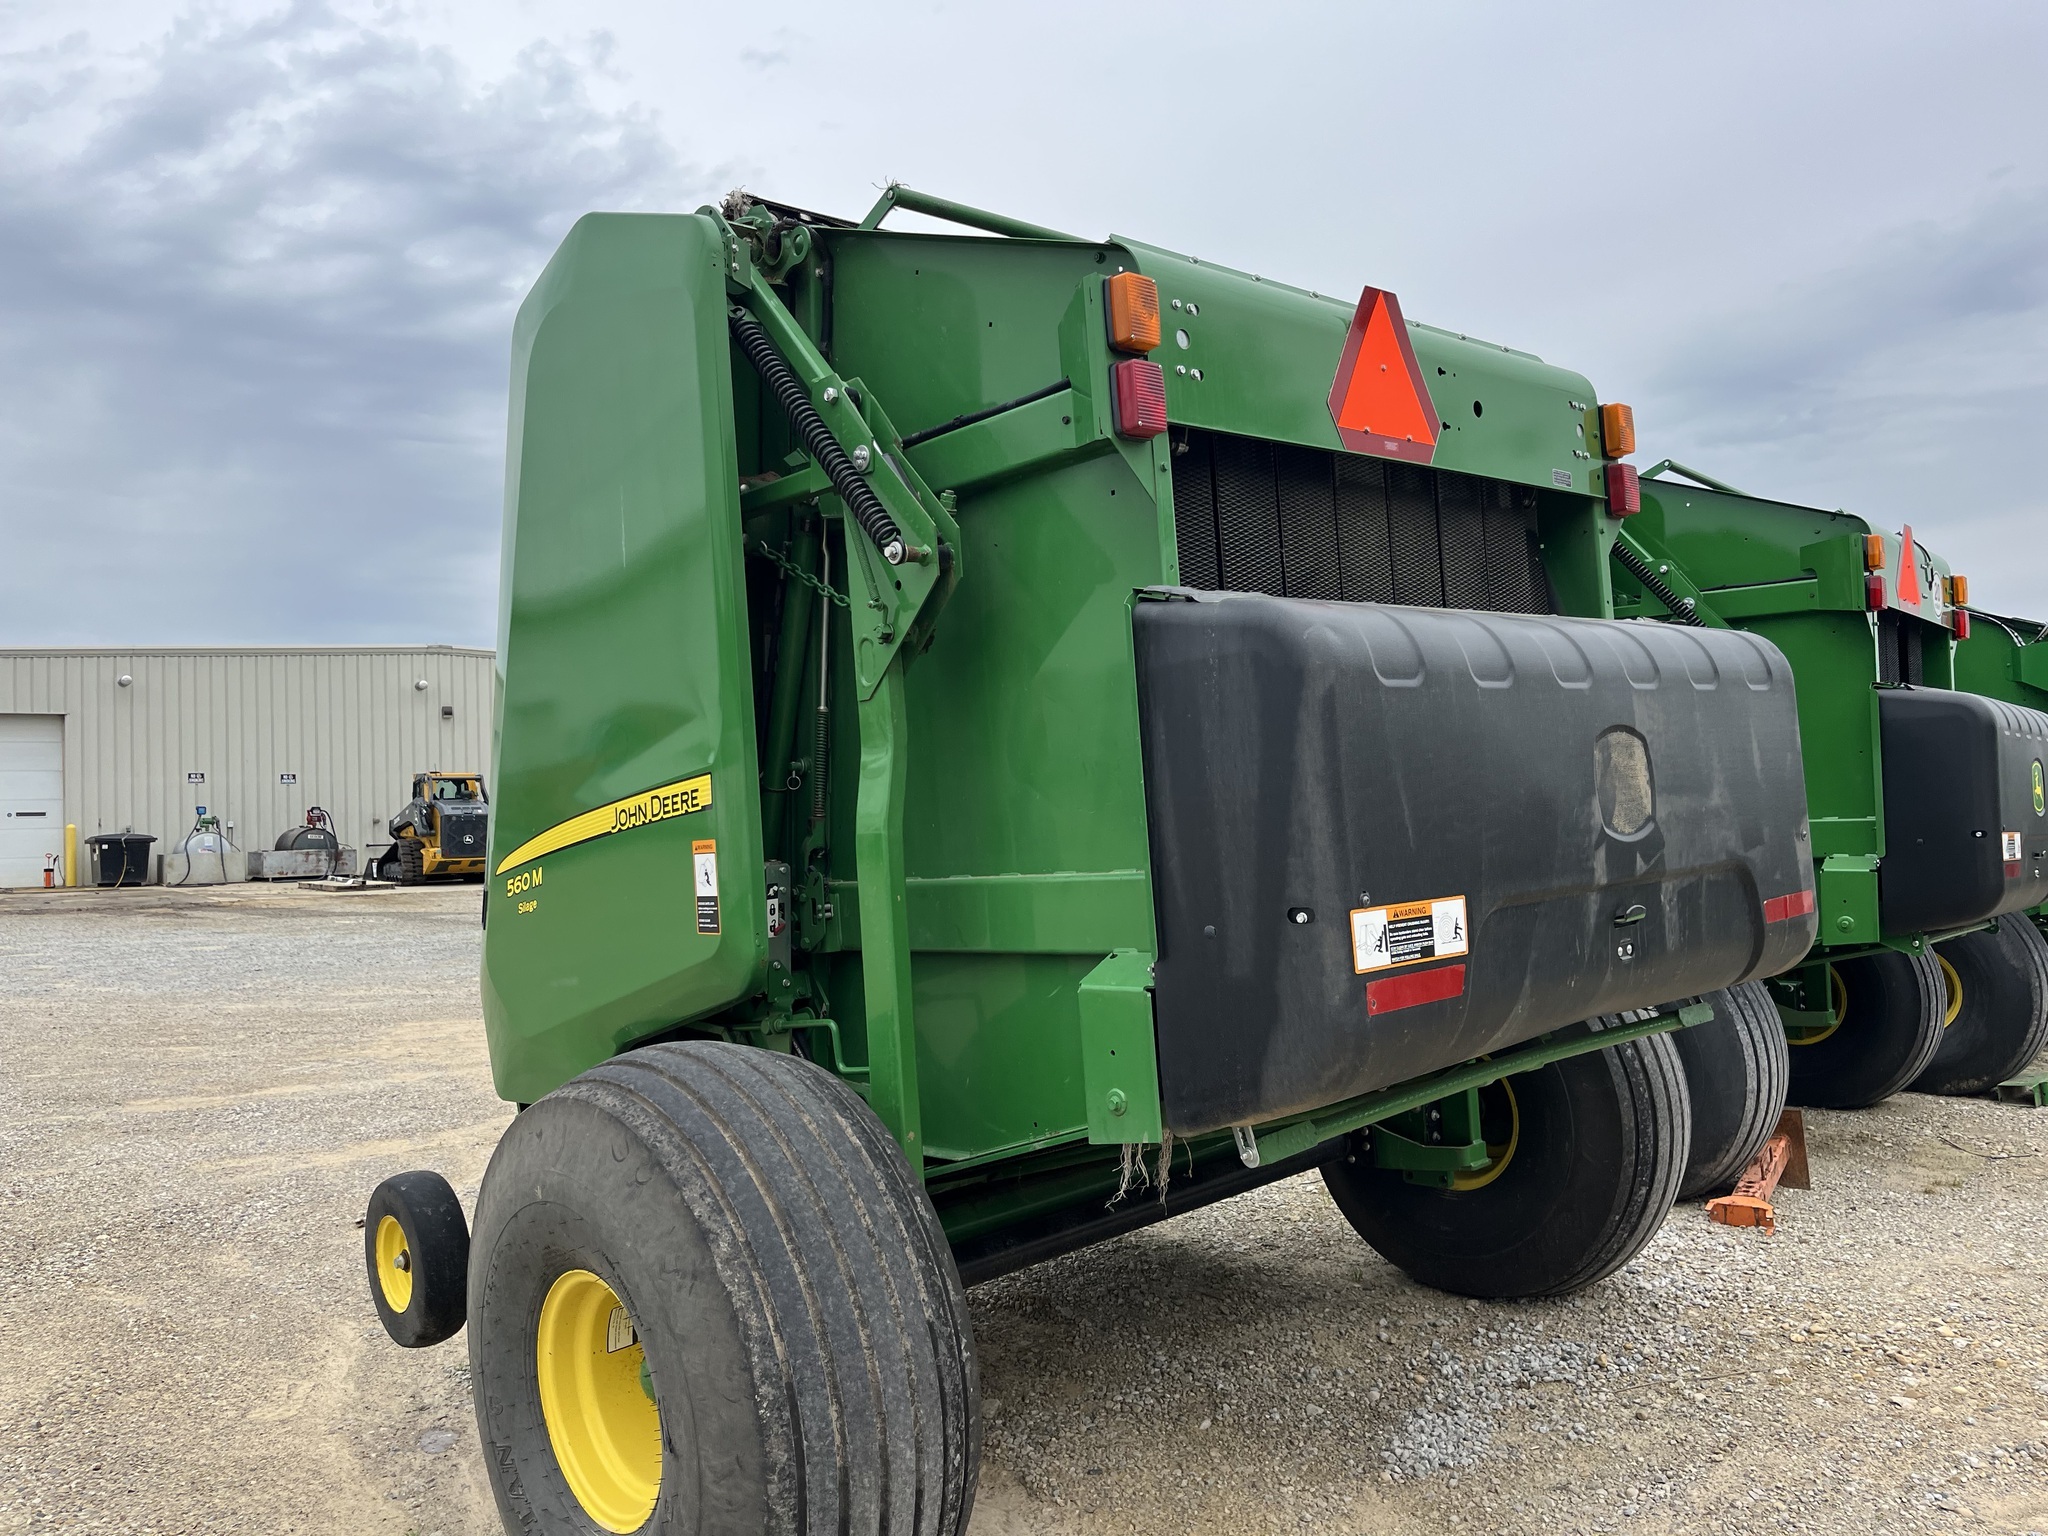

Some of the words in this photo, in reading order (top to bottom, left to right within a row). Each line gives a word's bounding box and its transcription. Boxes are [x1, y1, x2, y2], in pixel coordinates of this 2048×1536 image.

[611, 802, 648, 831] JOHN
[650, 787, 700, 819] DEERE
[506, 871, 531, 898] 560
[532, 865, 543, 888] M
[517, 899, 538, 914] Silage
[1399, 906, 1427, 917] WARNING
